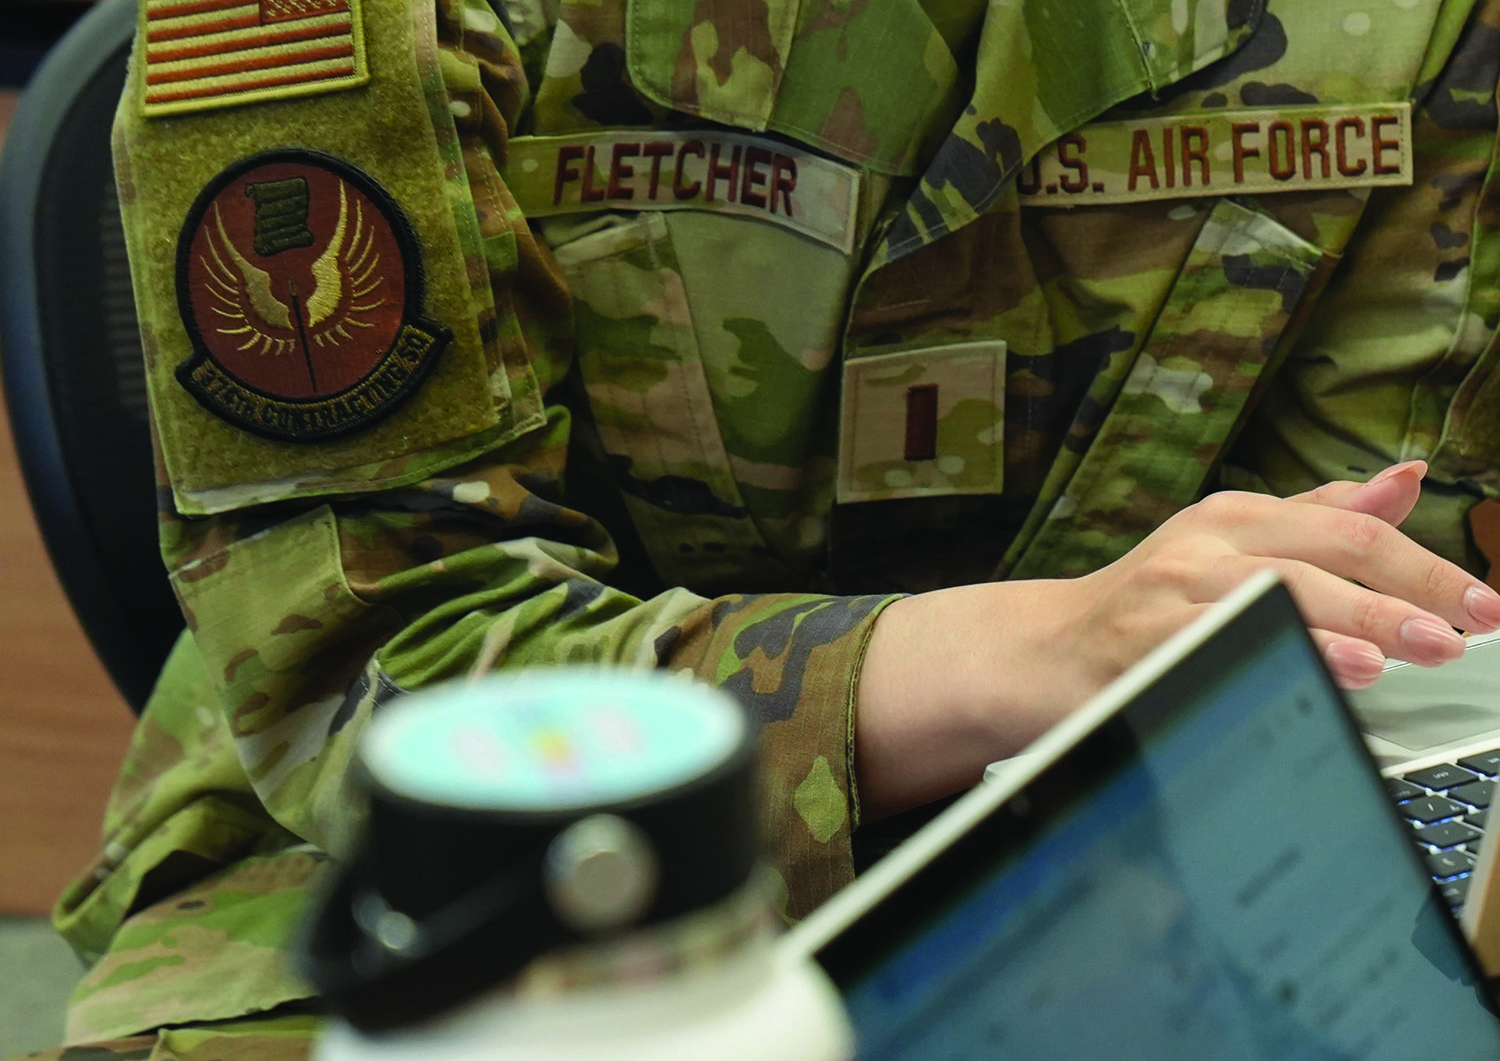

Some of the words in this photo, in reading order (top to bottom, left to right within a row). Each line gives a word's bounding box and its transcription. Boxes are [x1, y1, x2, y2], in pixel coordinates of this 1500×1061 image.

[553, 140, 797, 218] FLETCHER
[1127, 125, 1210, 192] AIR
[1232, 116, 1400, 185] FORCE
